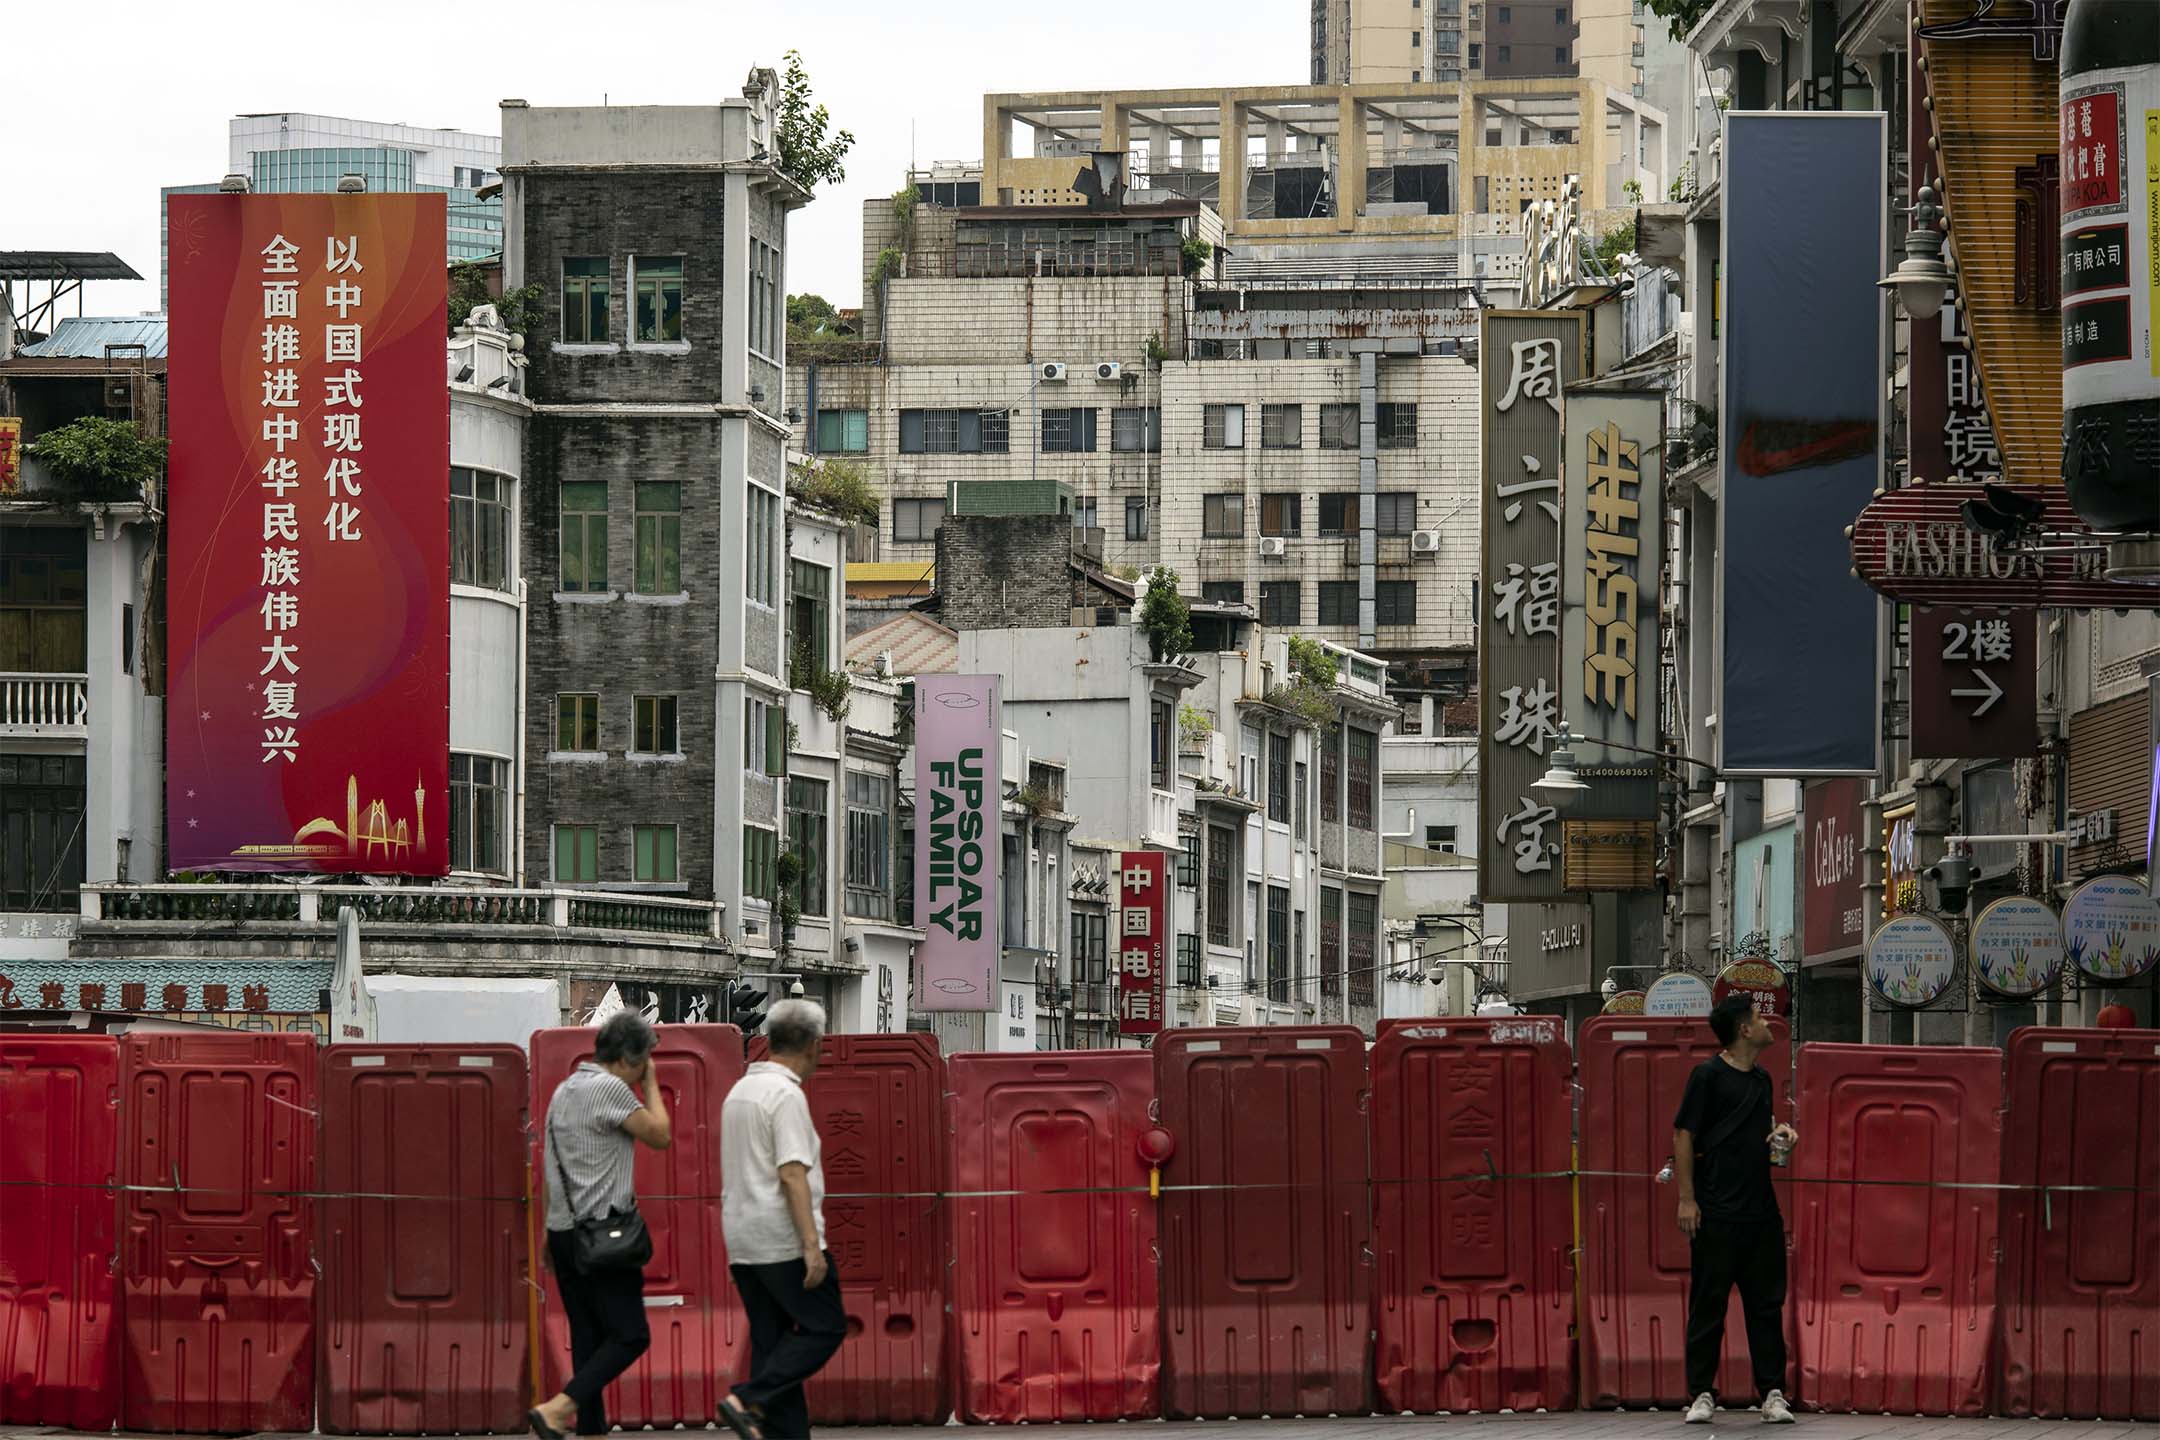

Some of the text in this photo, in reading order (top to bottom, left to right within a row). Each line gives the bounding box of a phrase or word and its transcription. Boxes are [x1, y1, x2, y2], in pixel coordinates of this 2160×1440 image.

[2083, 180, 2110, 201] KOA
[323, 236, 363, 542] 以中国式现代化
[260, 234, 302, 763] 全面推进中华民族伟大复兴
[1494, 338, 1563, 873] 周六福珠宝
[1942, 621, 2012, 662] 2楼
[930, 761, 955, 935] FAMILY
[957, 748, 983, 942] UPSOAR
[1121, 864, 1152, 1021] 中国电信
[1448, 1063, 1495, 1247] 安全文明
